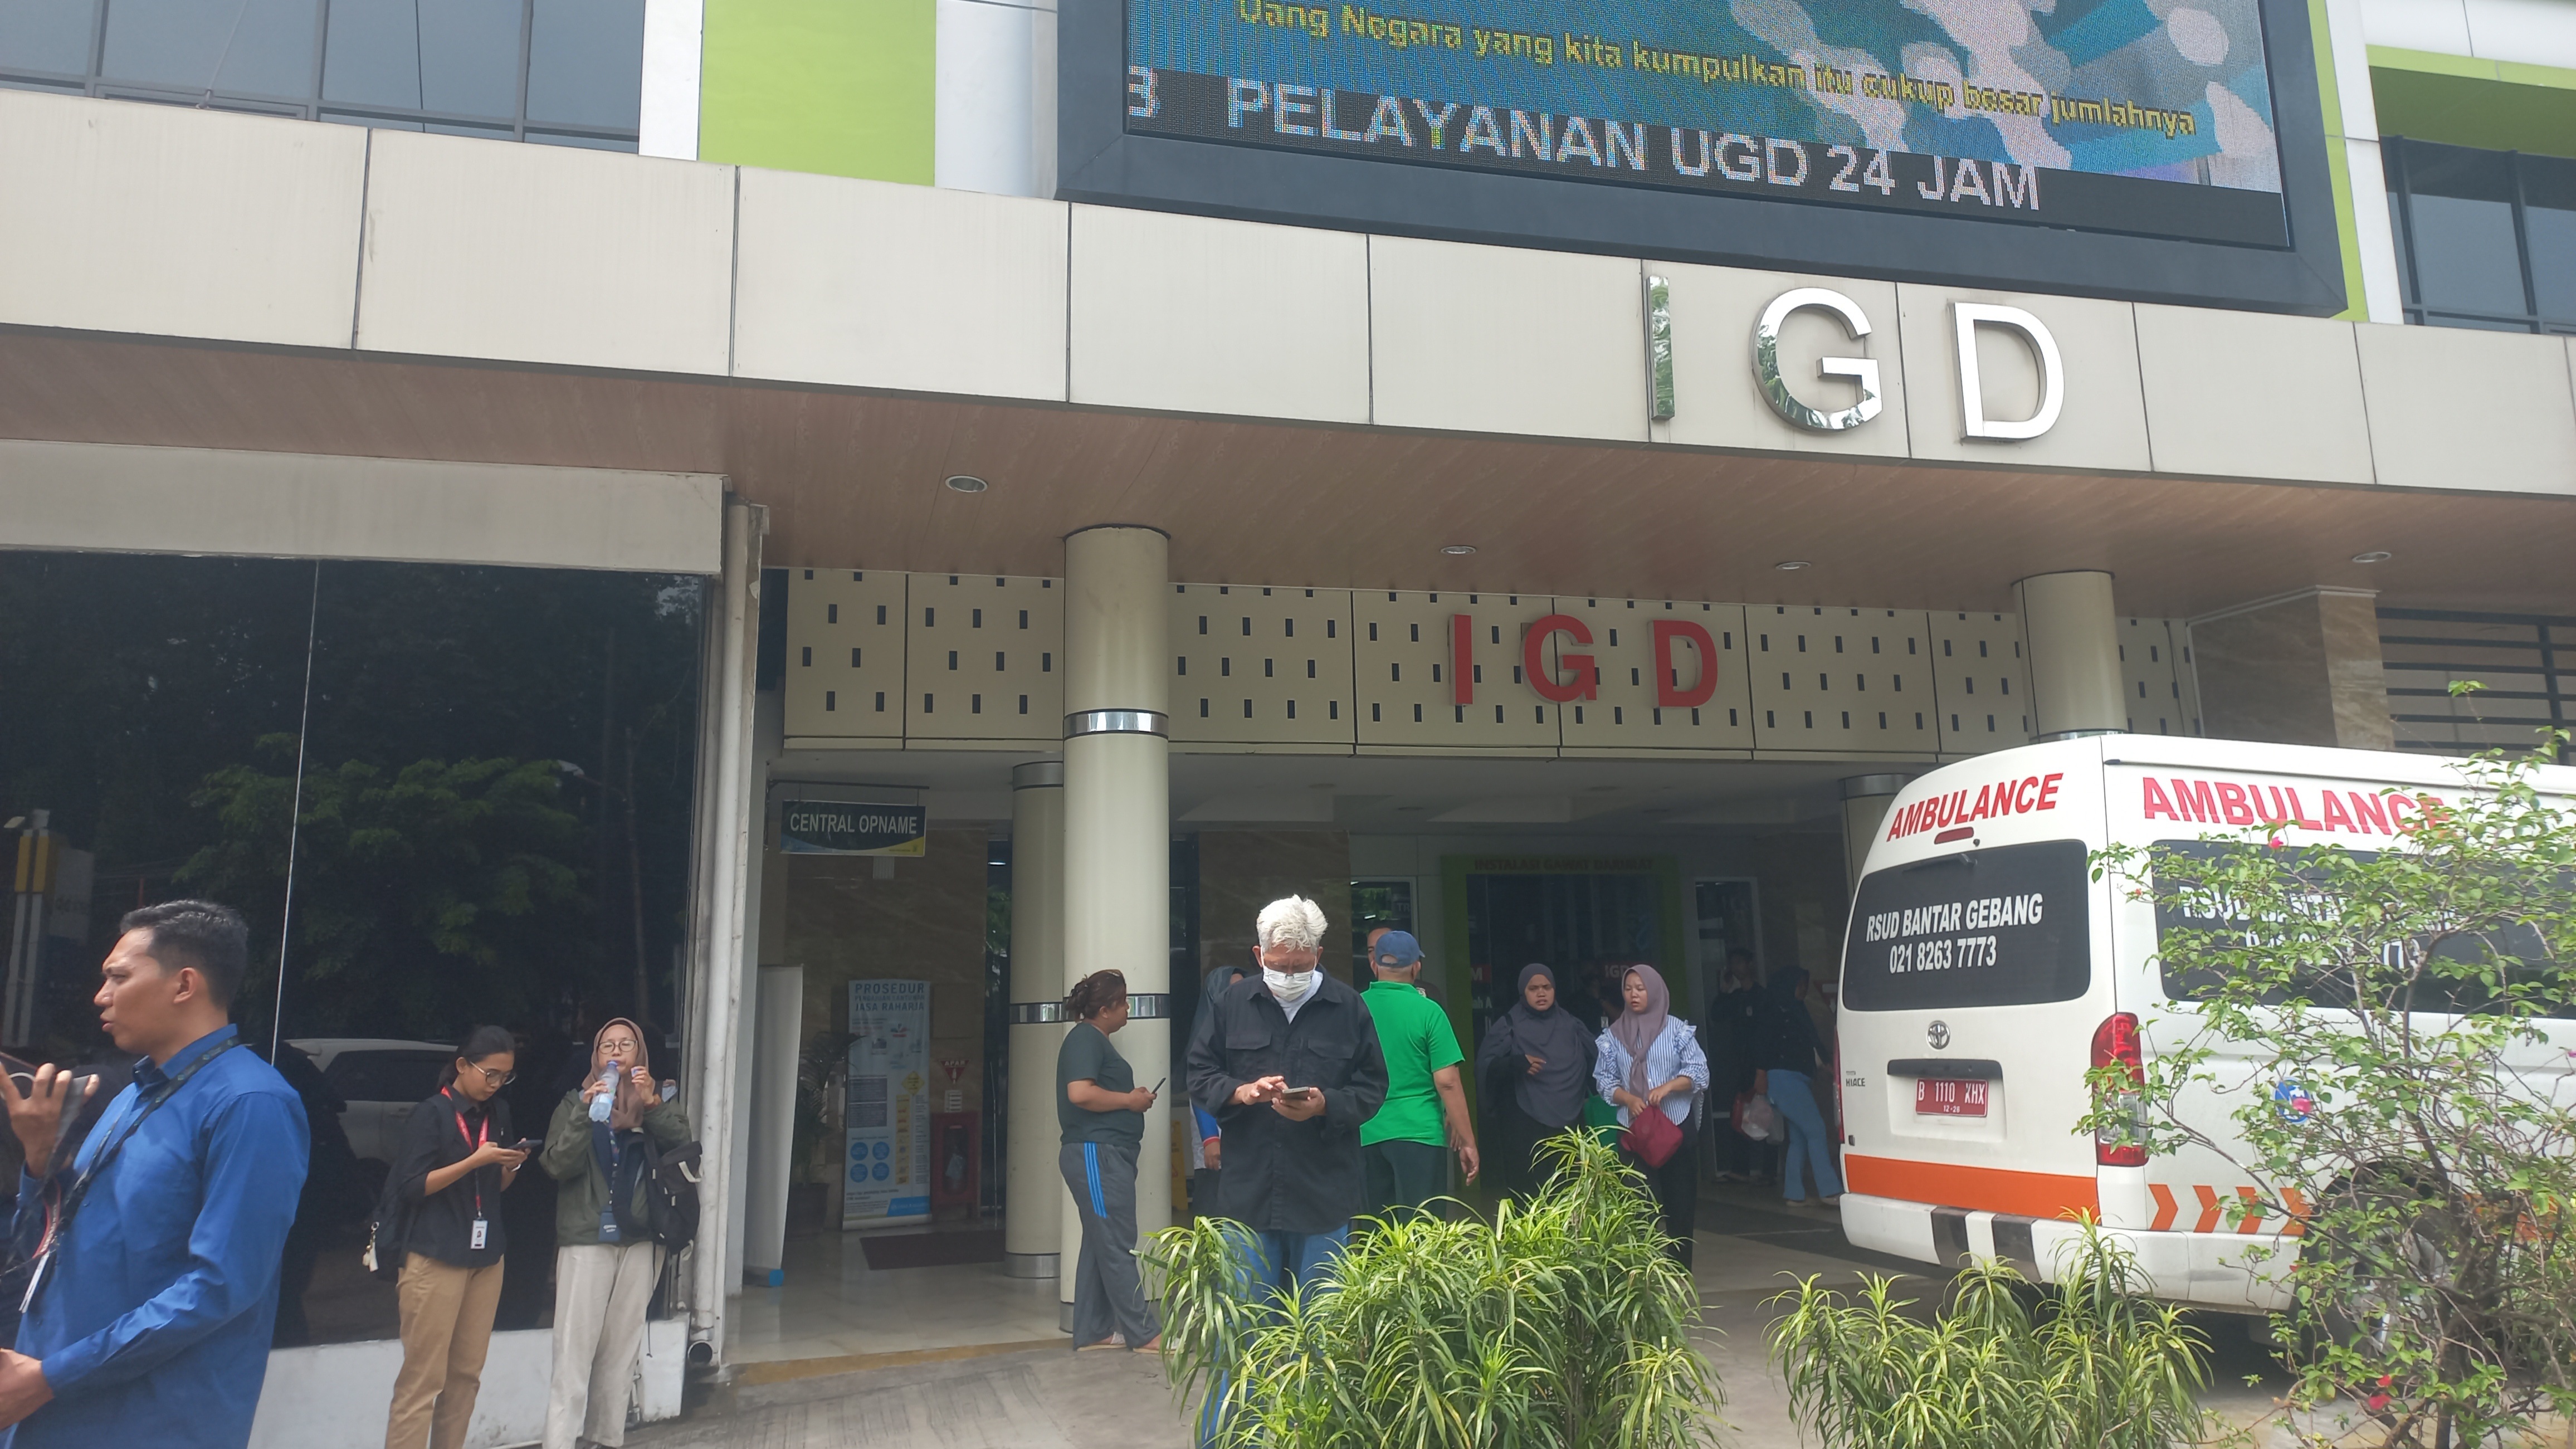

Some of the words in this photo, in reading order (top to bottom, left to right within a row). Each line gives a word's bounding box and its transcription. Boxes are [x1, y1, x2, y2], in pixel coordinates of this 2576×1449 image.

[1239, 0, 1329, 38] Uang
[1473, 28, 1553, 65] yang
[1563, 32, 1622, 68] kita
[1631, 39, 1806, 90] kumpulkan
[1814, 63, 1853, 95] itu
[1861, 74, 1955, 113] cukup
[2051, 90, 2196, 139] jumlahnya
[1227, 76, 1647, 172] PELAYANAN
[1670, 127, 1808, 188] UGD
[1827, 144, 1894, 196] 24
[1918, 155, 2041, 212] JAM
[1647, 274, 2065, 441] IGD
[1451, 613, 1719, 709] IGD
[790, 813, 855, 833] CENTRAL
[859, 814, 918, 835] OPNAME
[1886, 772, 2063, 842] AMBULANCE
[1866, 912, 1900, 943] RSUD
[1902, 902, 1962, 938] BANTAR
[1965, 892, 2043, 929] GEBANG
[1889, 946, 1913, 974] 021
[1916, 940, 1952, 972] 8263
[1956, 935, 1998, 968] 7773
[855, 983, 924, 994] PROSEDUR
[856, 1002, 877, 1011] JASA
[882, 1002, 924, 1011] RAHARJA
[1846, 1077, 1866, 1087] HIACE
[1918, 1081, 1925, 1101] B
[1935, 1081, 1955, 1102] 1110
